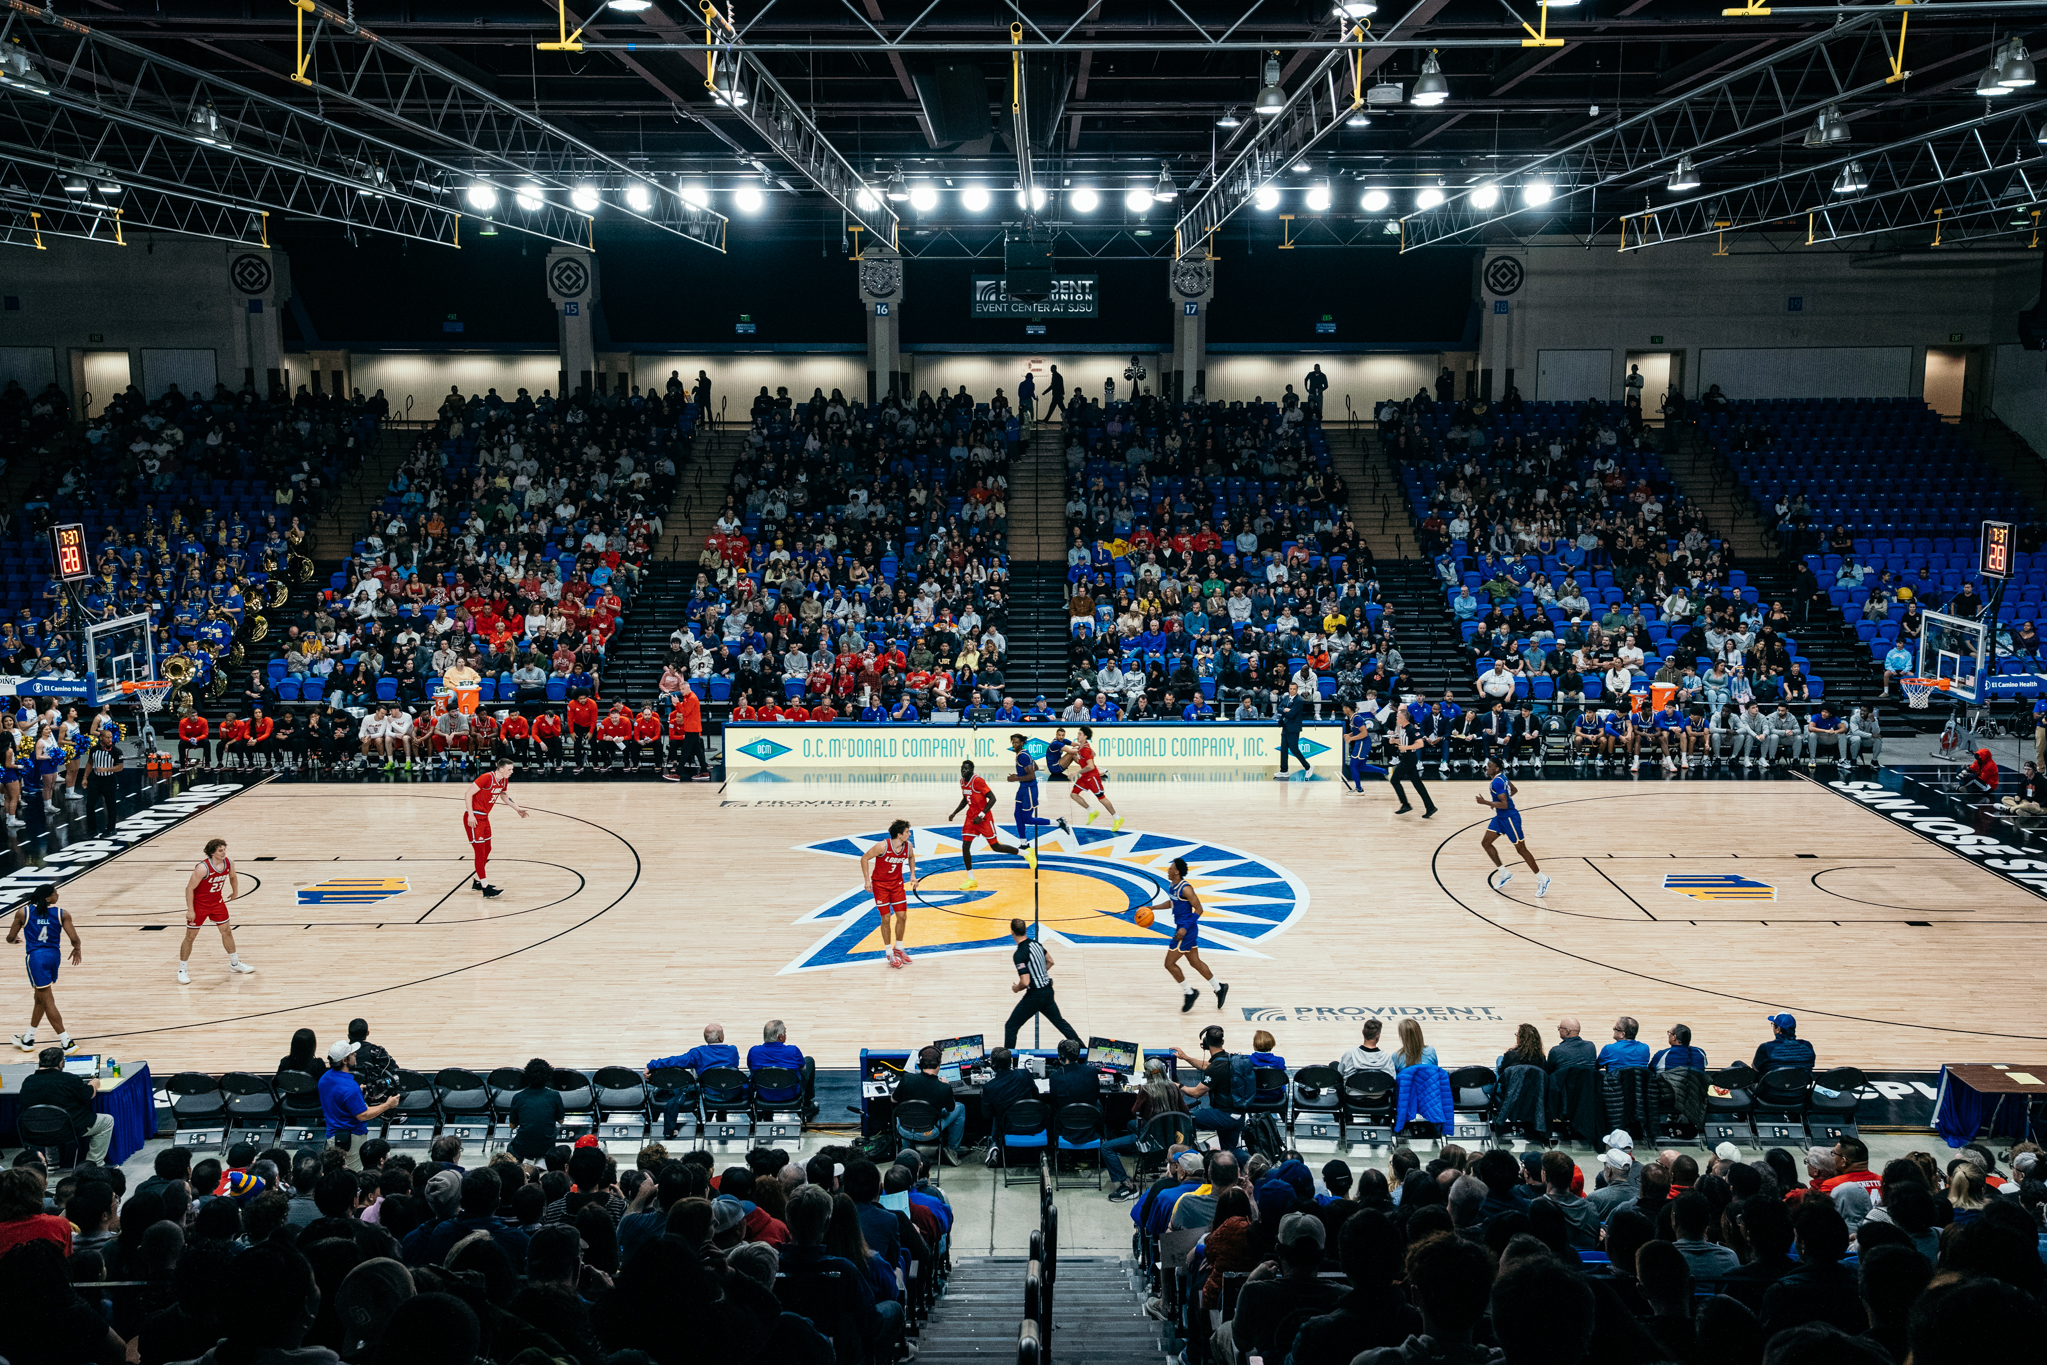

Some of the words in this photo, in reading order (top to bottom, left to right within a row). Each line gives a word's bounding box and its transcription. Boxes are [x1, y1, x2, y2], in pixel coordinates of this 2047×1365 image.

[1000, 280, 1093, 293] PDENT
[565, 304, 577, 314] 15
[876, 304, 888, 315] 16
[976, 303, 1008, 312] EVENT
[1011, 303, 1050, 312] CENTER
[1052, 303, 1065, 312] AT
[1068, 303, 1093, 312] SJSU
[1185, 304, 1197, 314] 17
[1495, 302, 1507, 312] 18
[61, 530, 79, 545] 7:37
[61, 546, 80, 573] 28
[1989, 544, 2005, 571] 28
[757, 744, 772, 754] OCM
[902, 738, 970, 760] COMPANY,
[974, 738, 999, 758] INC.
[1171, 737, 1239, 760] COMPANY,
[1243, 737, 1268, 757] INC.
[1828, 780, 1930, 810] SAN
[42, 783, 244, 863] SPARTANS
[888, 864, 897, 873] 3
[209, 882, 224, 893] 23
[38, 925, 49, 943] 4
[1294, 1006, 1496, 1015] PROVIDENT
